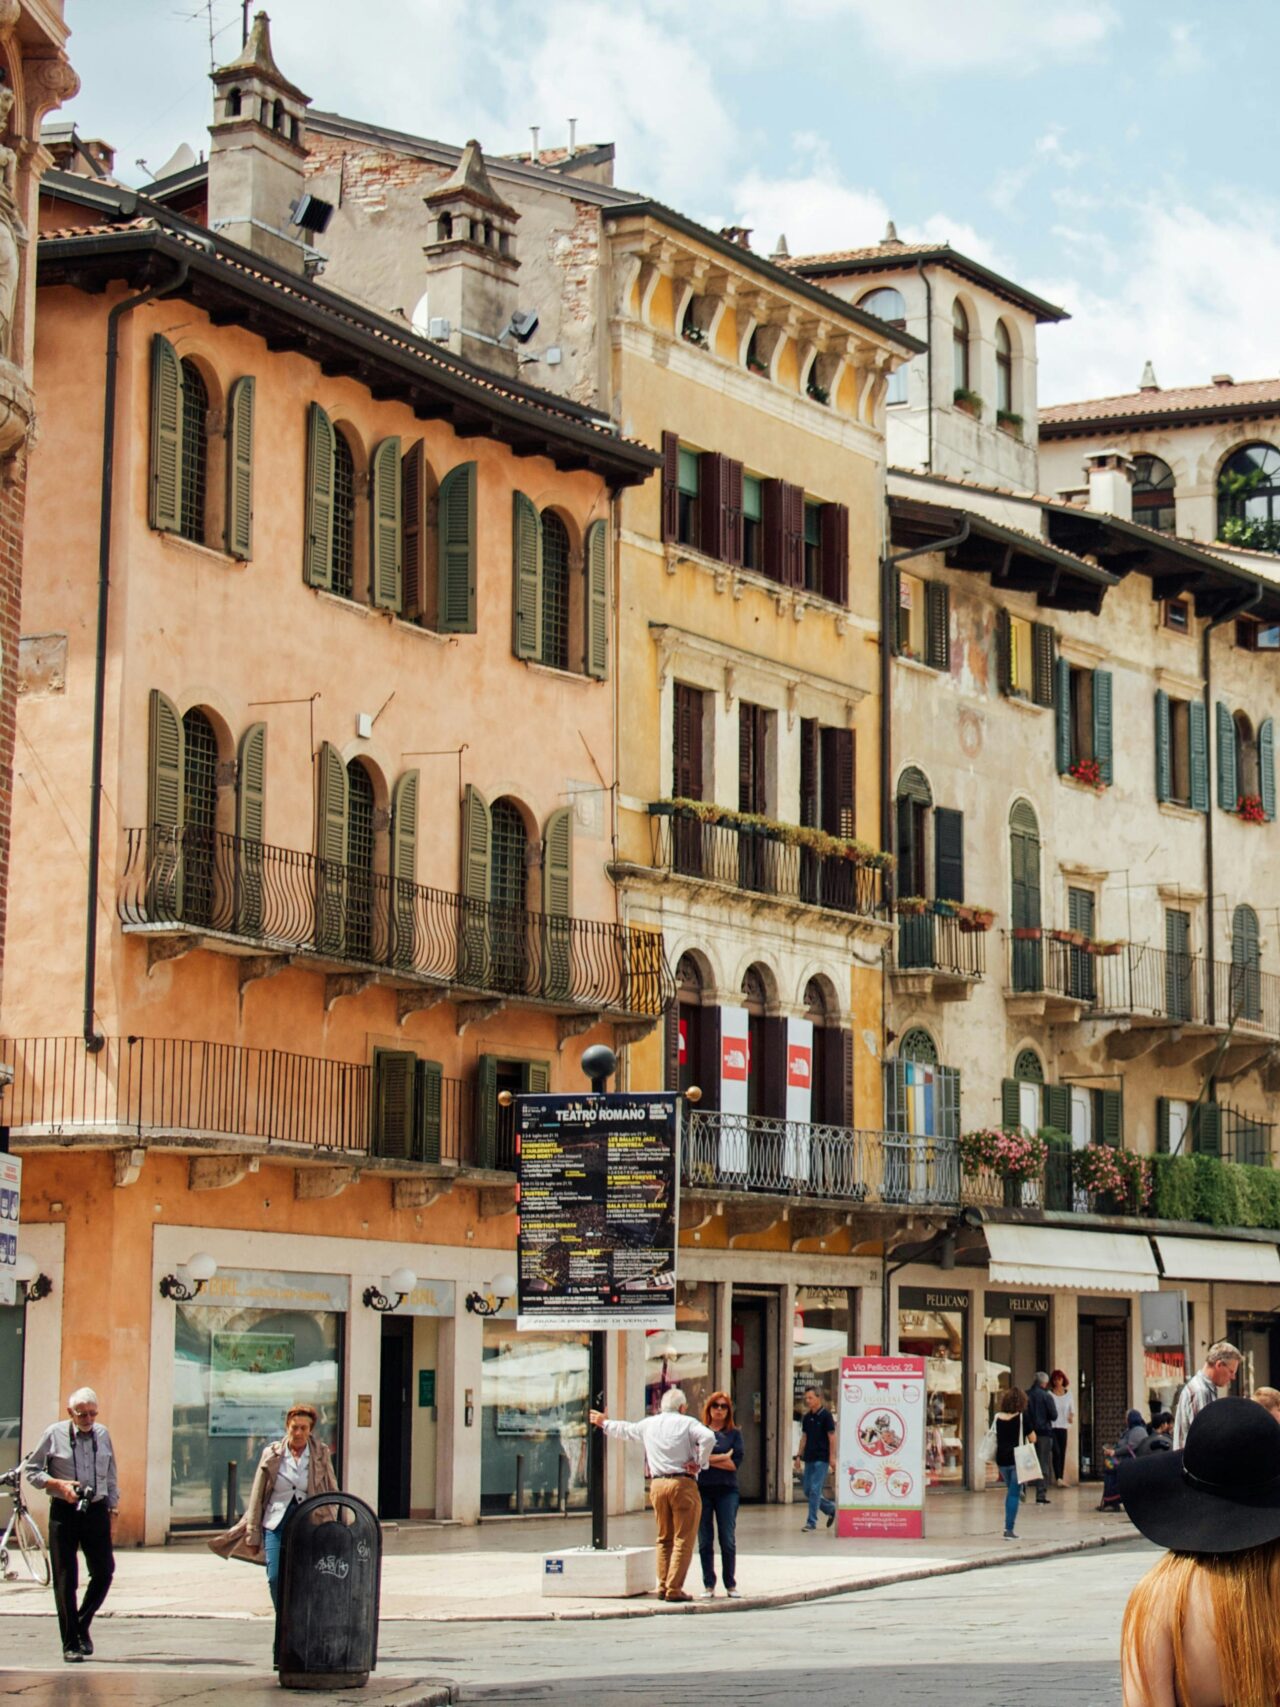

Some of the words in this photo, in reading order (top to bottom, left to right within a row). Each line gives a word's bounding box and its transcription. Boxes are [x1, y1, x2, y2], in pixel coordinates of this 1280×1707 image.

[555, 1109, 597, 1121] TEATRO
[599, 1109, 645, 1120] ROMANO
[209, 1276, 240, 1297] BNL
[926, 1293, 969, 1308] PELLICANO
[1008, 1298, 1049, 1312] PELLICANO
[852, 1363, 865, 1371] Via
[903, 1363, 913, 1371] 22
